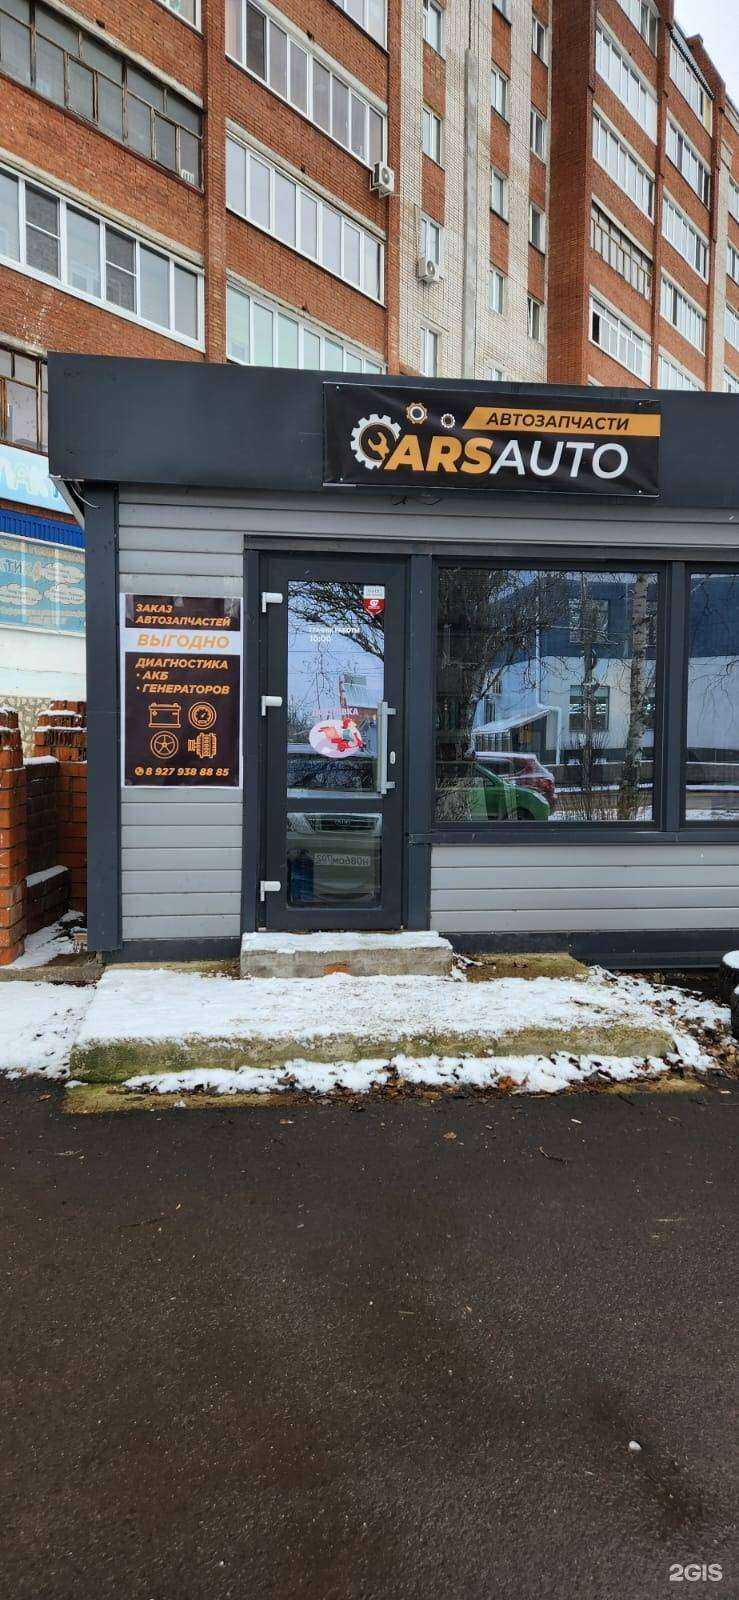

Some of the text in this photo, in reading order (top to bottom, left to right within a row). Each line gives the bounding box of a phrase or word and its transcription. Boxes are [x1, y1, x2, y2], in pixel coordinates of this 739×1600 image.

[486, 411, 629, 431] АВТОЗАПЧАСТИ
[136, 603, 173, 614] ЗАКАЗ
[135, 615, 232, 627] АВТОЗАПЧАСТЕЙ
[137, 634, 229, 650] ВЫГОДНО
[135, 658, 229, 670] ДИАГНОСТИКА
[142, 671, 169, 681] АКБ
[142, 683, 230, 695] ГЕНЕРАТОРОВ
[145, 767, 229, 776] 8 927 938 88 85
